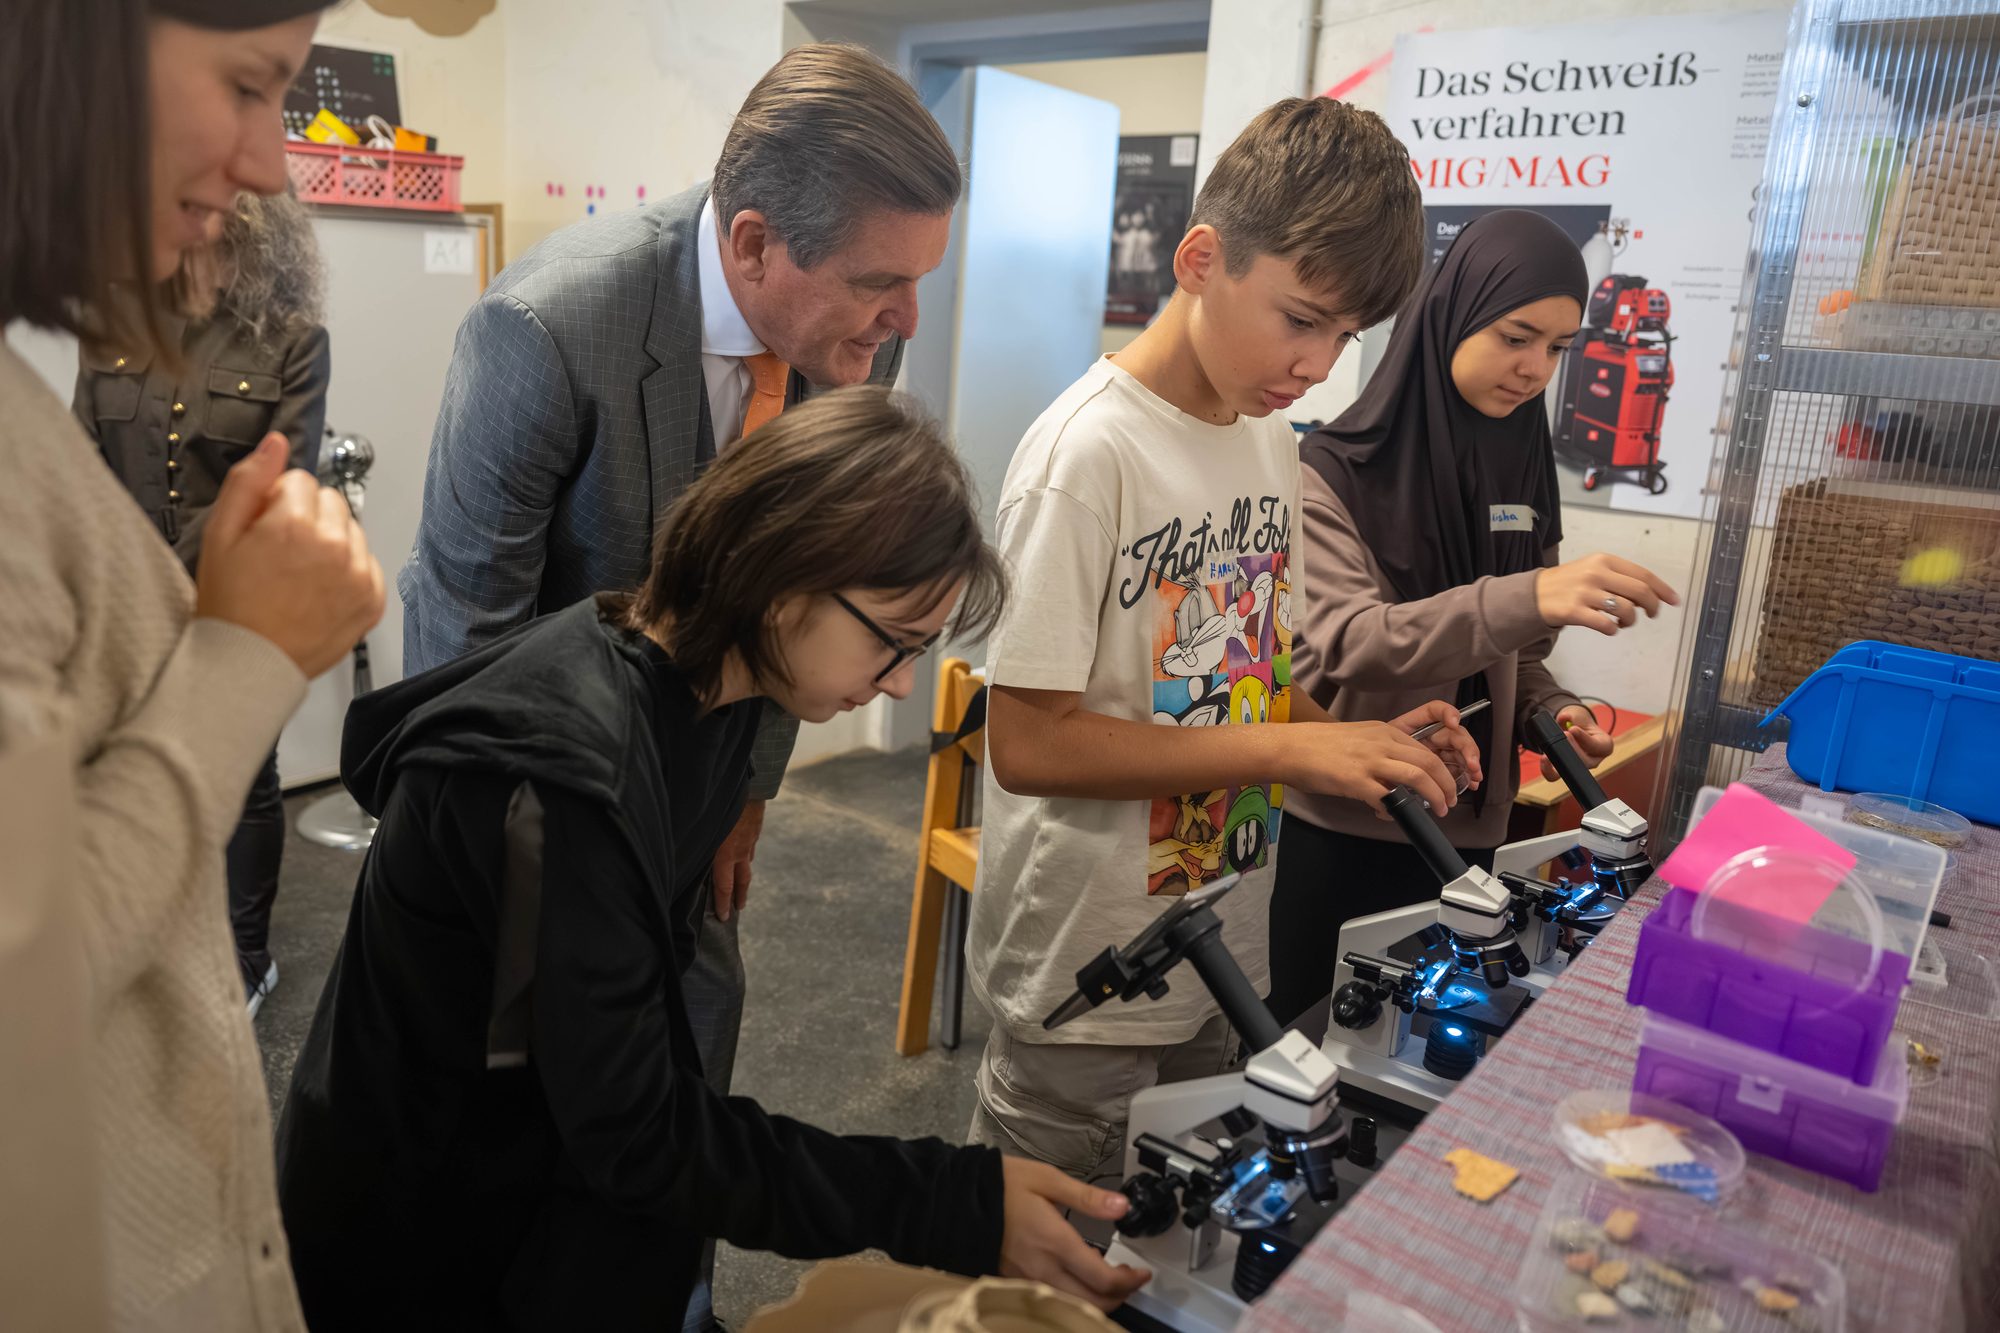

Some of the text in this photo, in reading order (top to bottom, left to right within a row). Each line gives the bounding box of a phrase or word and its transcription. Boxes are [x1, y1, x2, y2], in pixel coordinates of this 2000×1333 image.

[1415, 66, 1491, 99] Das
[1411, 106, 1626, 142] verfahren
[1409, 154, 1612, 189] MIG/MAG
[1253, 495, 1290, 555] Fol
